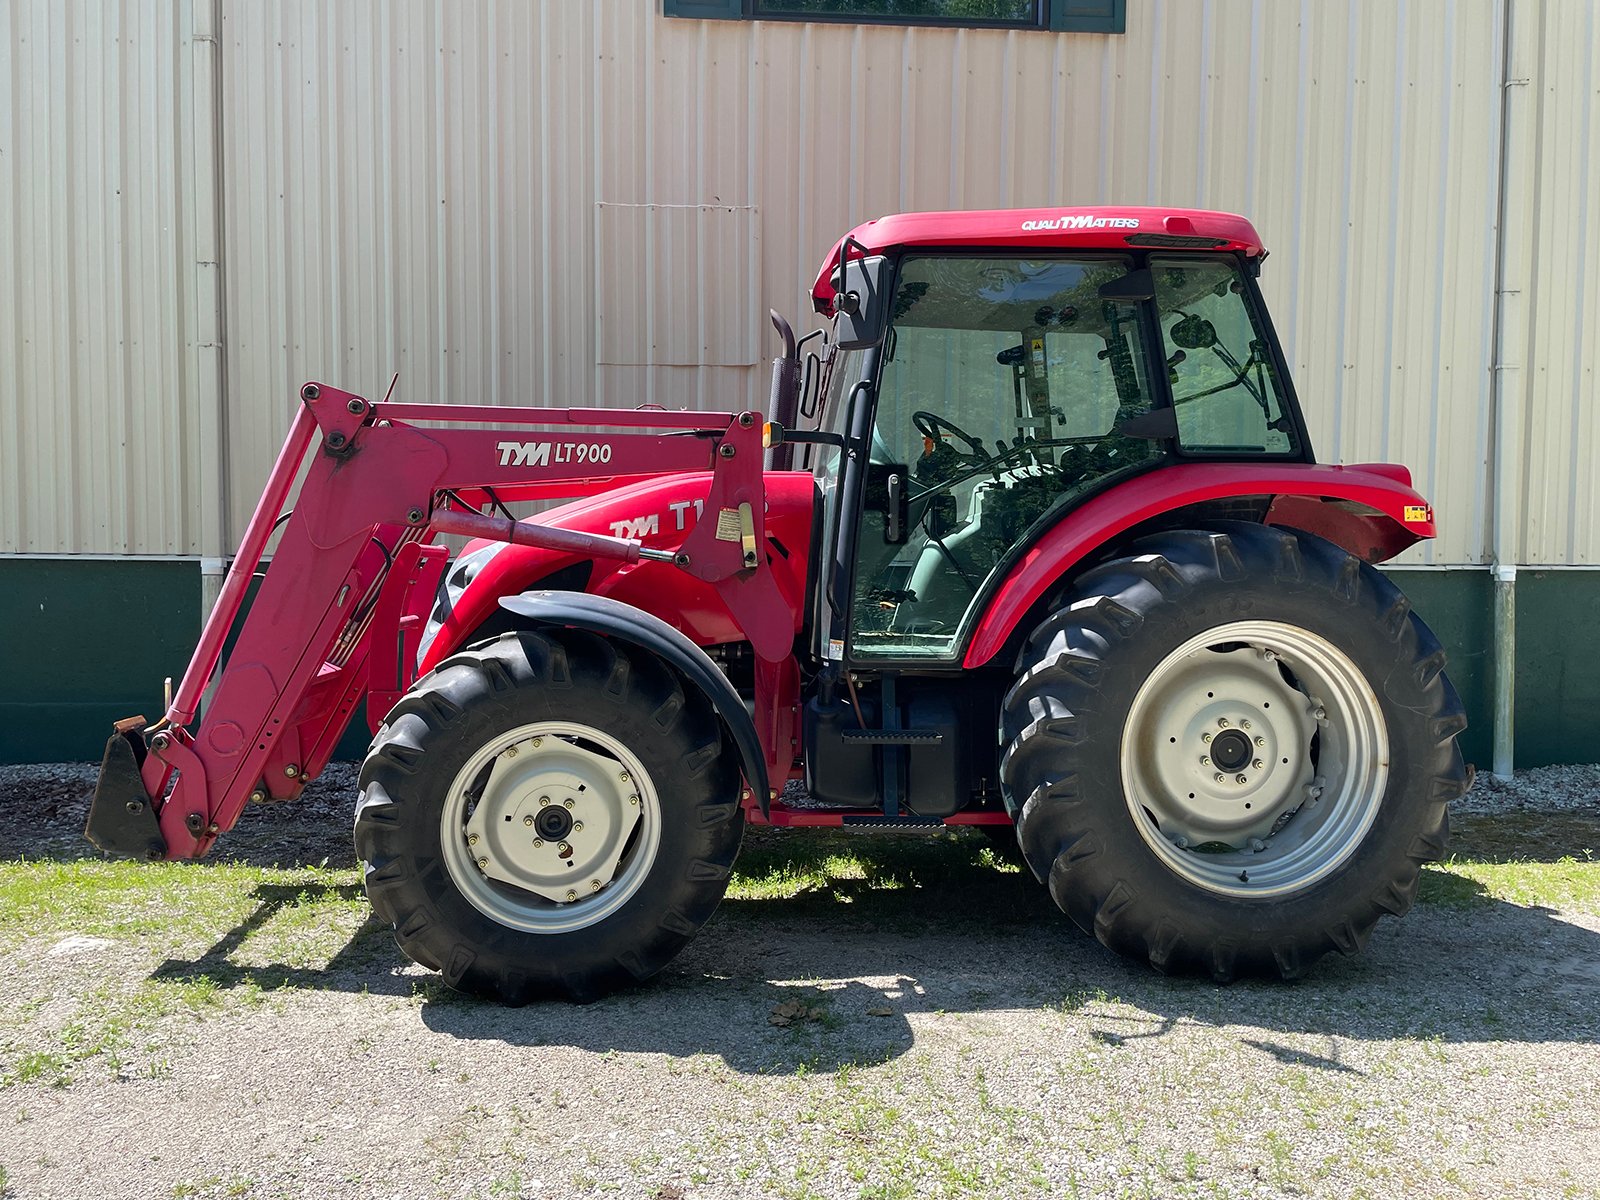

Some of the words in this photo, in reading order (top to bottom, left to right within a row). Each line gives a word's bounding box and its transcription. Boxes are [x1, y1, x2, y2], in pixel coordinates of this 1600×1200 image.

[1021, 215, 1140, 231] QUALITYMATTERS
[497, 441, 552, 467] TYM
[555, 443, 612, 463] LT900
[609, 513, 659, 539] TYM
